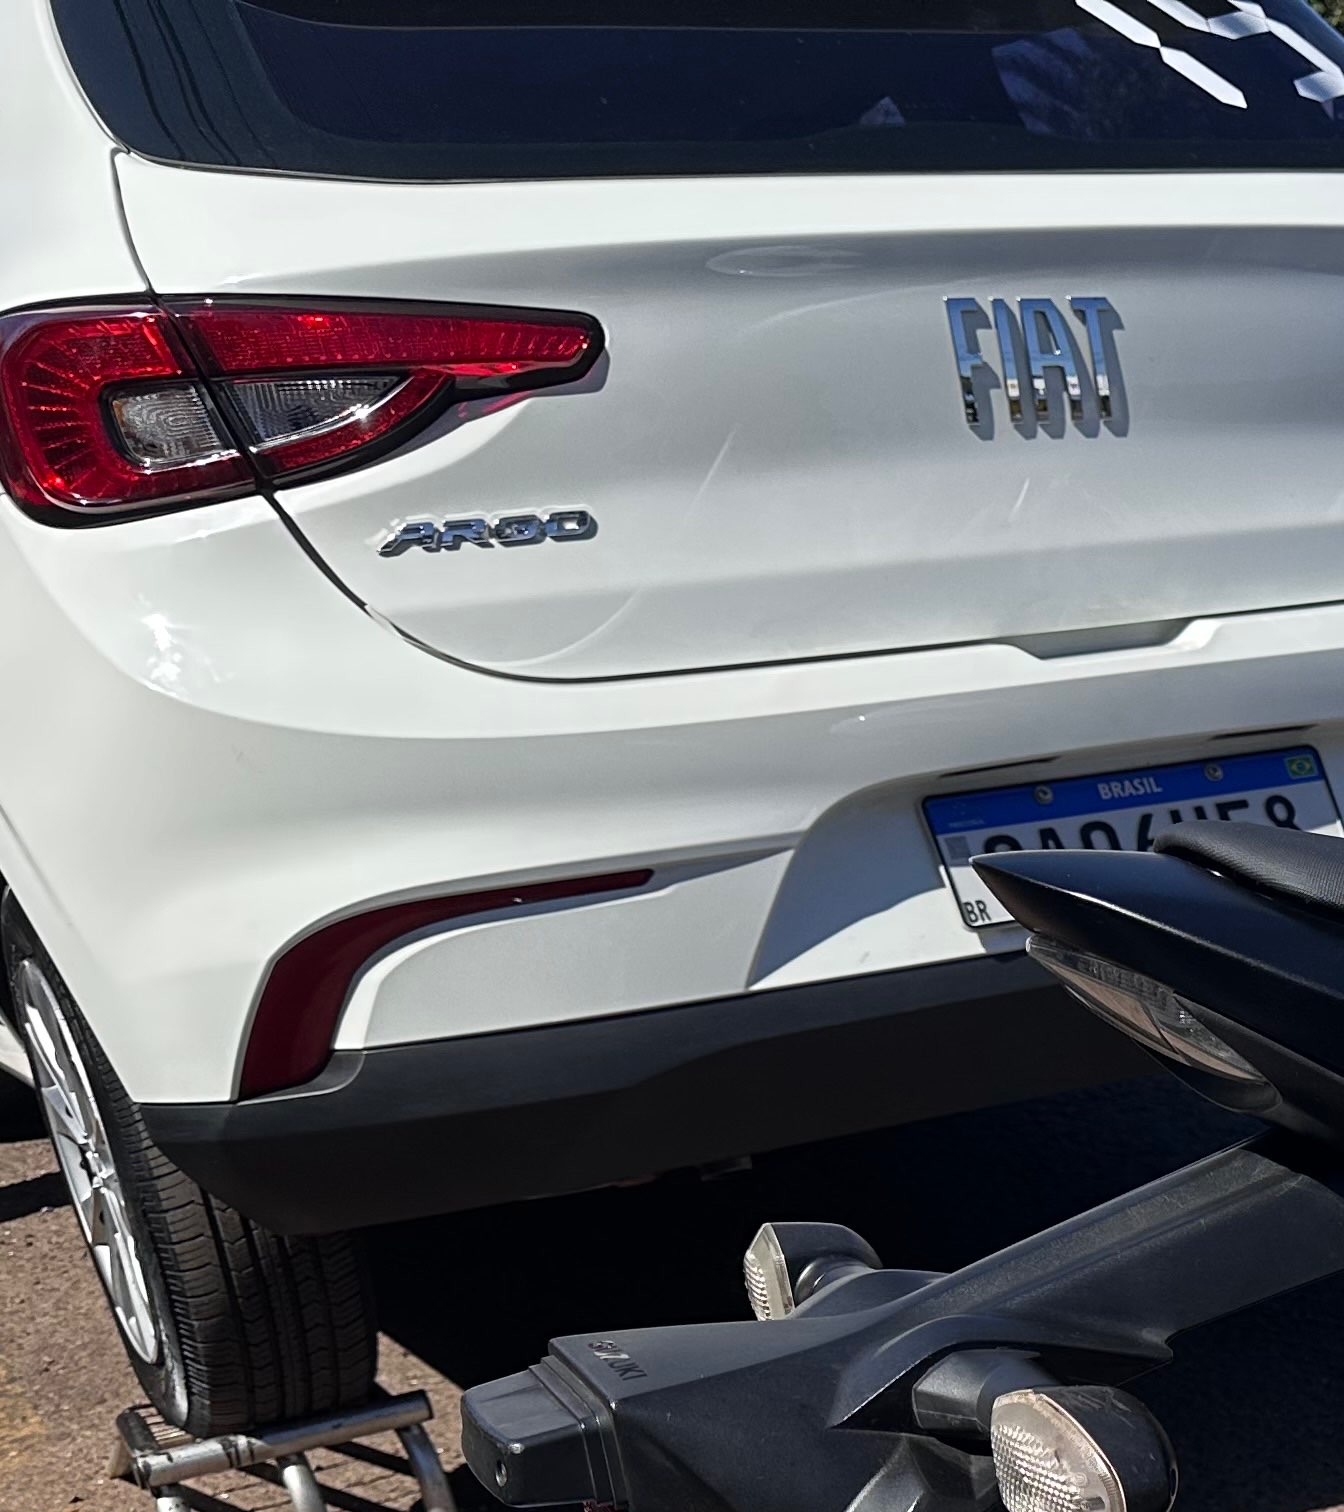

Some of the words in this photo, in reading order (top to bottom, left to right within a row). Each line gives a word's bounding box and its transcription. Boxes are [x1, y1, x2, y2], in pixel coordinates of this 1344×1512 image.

[943, 296, 1114, 426] FIAT
[377, 509, 599, 557] ARGO
[1098, 777, 1163, 800] BRASIL
[963, 900, 992, 923] BR
